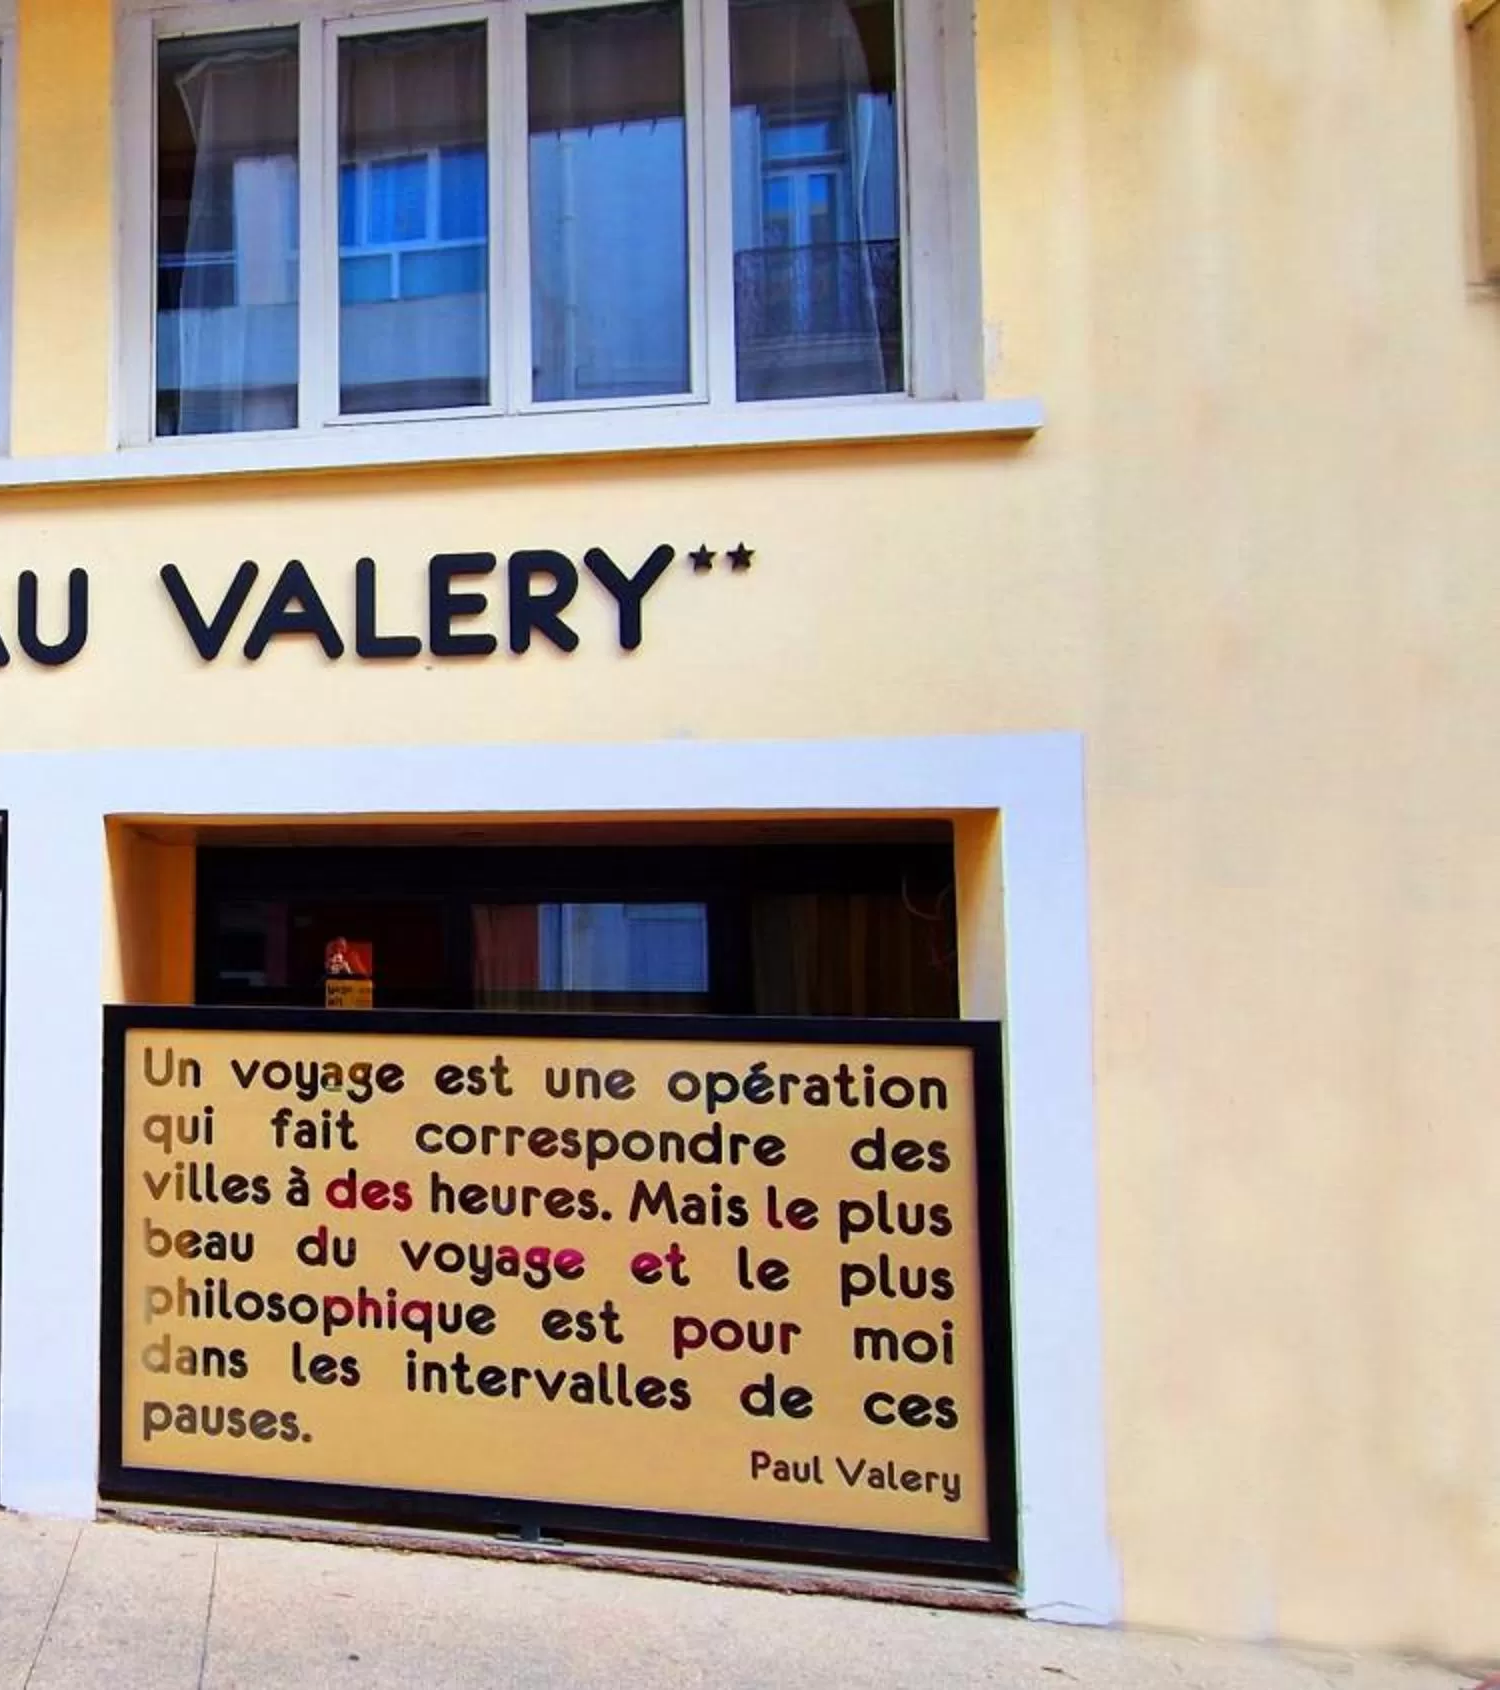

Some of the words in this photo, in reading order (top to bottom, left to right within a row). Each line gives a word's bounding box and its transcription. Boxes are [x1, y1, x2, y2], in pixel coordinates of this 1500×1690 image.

[160, 543, 675, 662] VALERY
[143, 1047, 201, 1089] Un
[231, 1059, 404, 1103] voyage
[434, 1055, 513, 1097] est
[545, 1066, 636, 1101] une
[667, 1061, 948, 1115] opération
[143, 1105, 214, 1154] qui
[270, 1107, 359, 1151] fait
[415, 1120, 787, 1171] correspondre
[850, 1126, 951, 1173] des
[143, 1161, 271, 1204] villes
[285, 1166, 310, 1207] à
[325, 1167, 413, 1213] des
[430, 1171, 612, 1222] heures.
[629, 1179, 749, 1228] Mais
[766, 1185, 819, 1231] le
[838, 1190, 953, 1244] plus
[143, 1217, 254, 1262] beau
[296, 1224, 357, 1268] du
[400, 1239, 585, 1290] voyage
[630, 1242, 690, 1287] et
[737, 1245, 790, 1292] le
[840, 1252, 955, 1307] plus
[143, 1275, 496, 1343] philosophique
[541, 1300, 624, 1345] est
[673, 1314, 801, 1360] pour
[853, 1320, 954, 1365] moi
[142, 1333, 248, 1378] dans
[291, 1341, 361, 1387] les
[405, 1349, 692, 1411] intervalles
[739, 1373, 813, 1419] de
[863, 1391, 959, 1429] ces
[142, 1400, 313, 1442] pauses.
[750, 1449, 823, 1485] Paul
[835, 1456, 961, 1502] Valery
